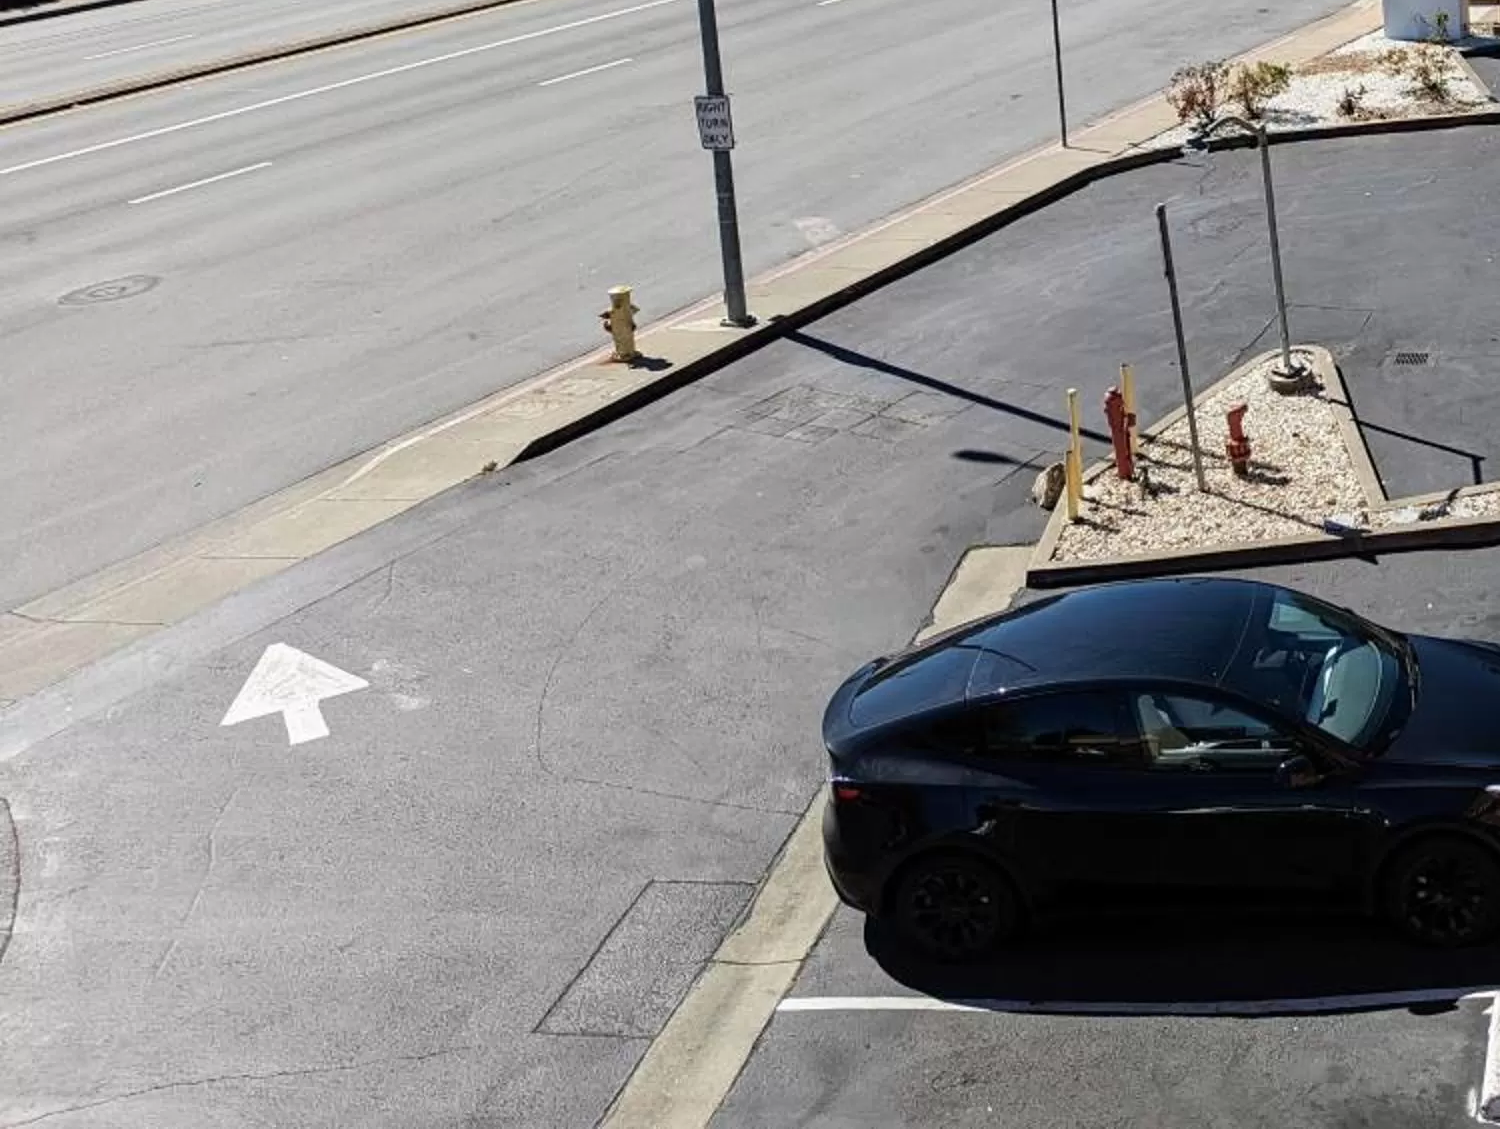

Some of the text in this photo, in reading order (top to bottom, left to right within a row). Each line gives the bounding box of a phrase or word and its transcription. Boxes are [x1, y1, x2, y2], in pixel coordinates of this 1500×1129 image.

[698, 102, 725, 112] RIGHT
[701, 118, 728, 128] TURN
[704, 134, 729, 145] ONLY
